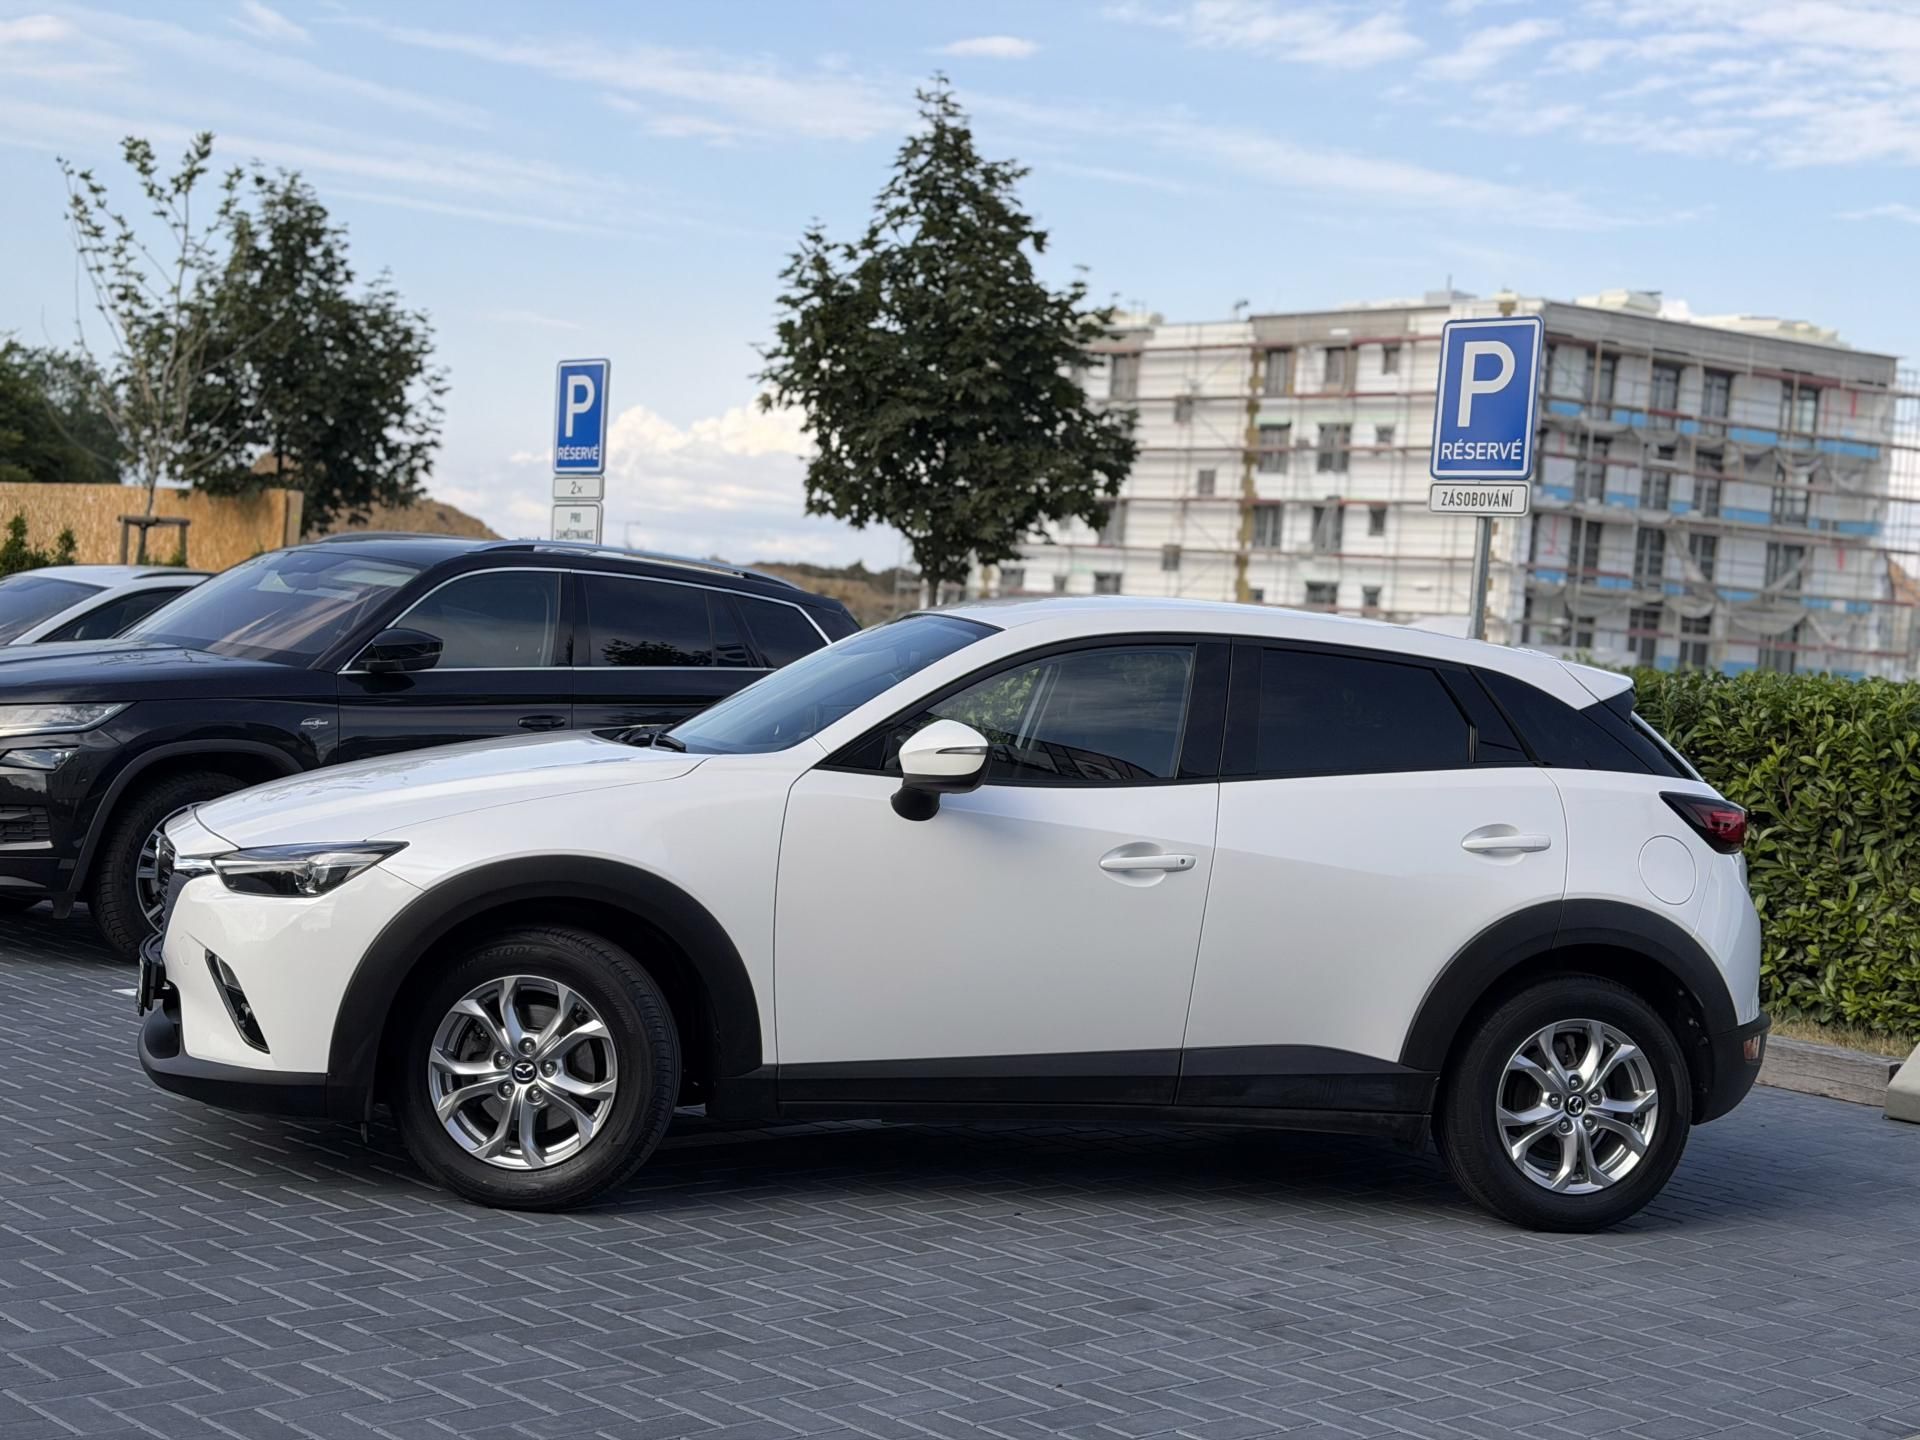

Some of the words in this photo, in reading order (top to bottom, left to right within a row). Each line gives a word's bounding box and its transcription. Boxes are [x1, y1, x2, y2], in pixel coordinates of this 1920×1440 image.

[1457, 340, 1516, 428] P
[565, 374, 595, 438] P
[557, 444, 599, 461] RÉSERVÉ
[1441, 438, 1523, 460] RÉSERVÉ
[1441, 488, 1515, 508] ZÁSOBOVÁNÍ
